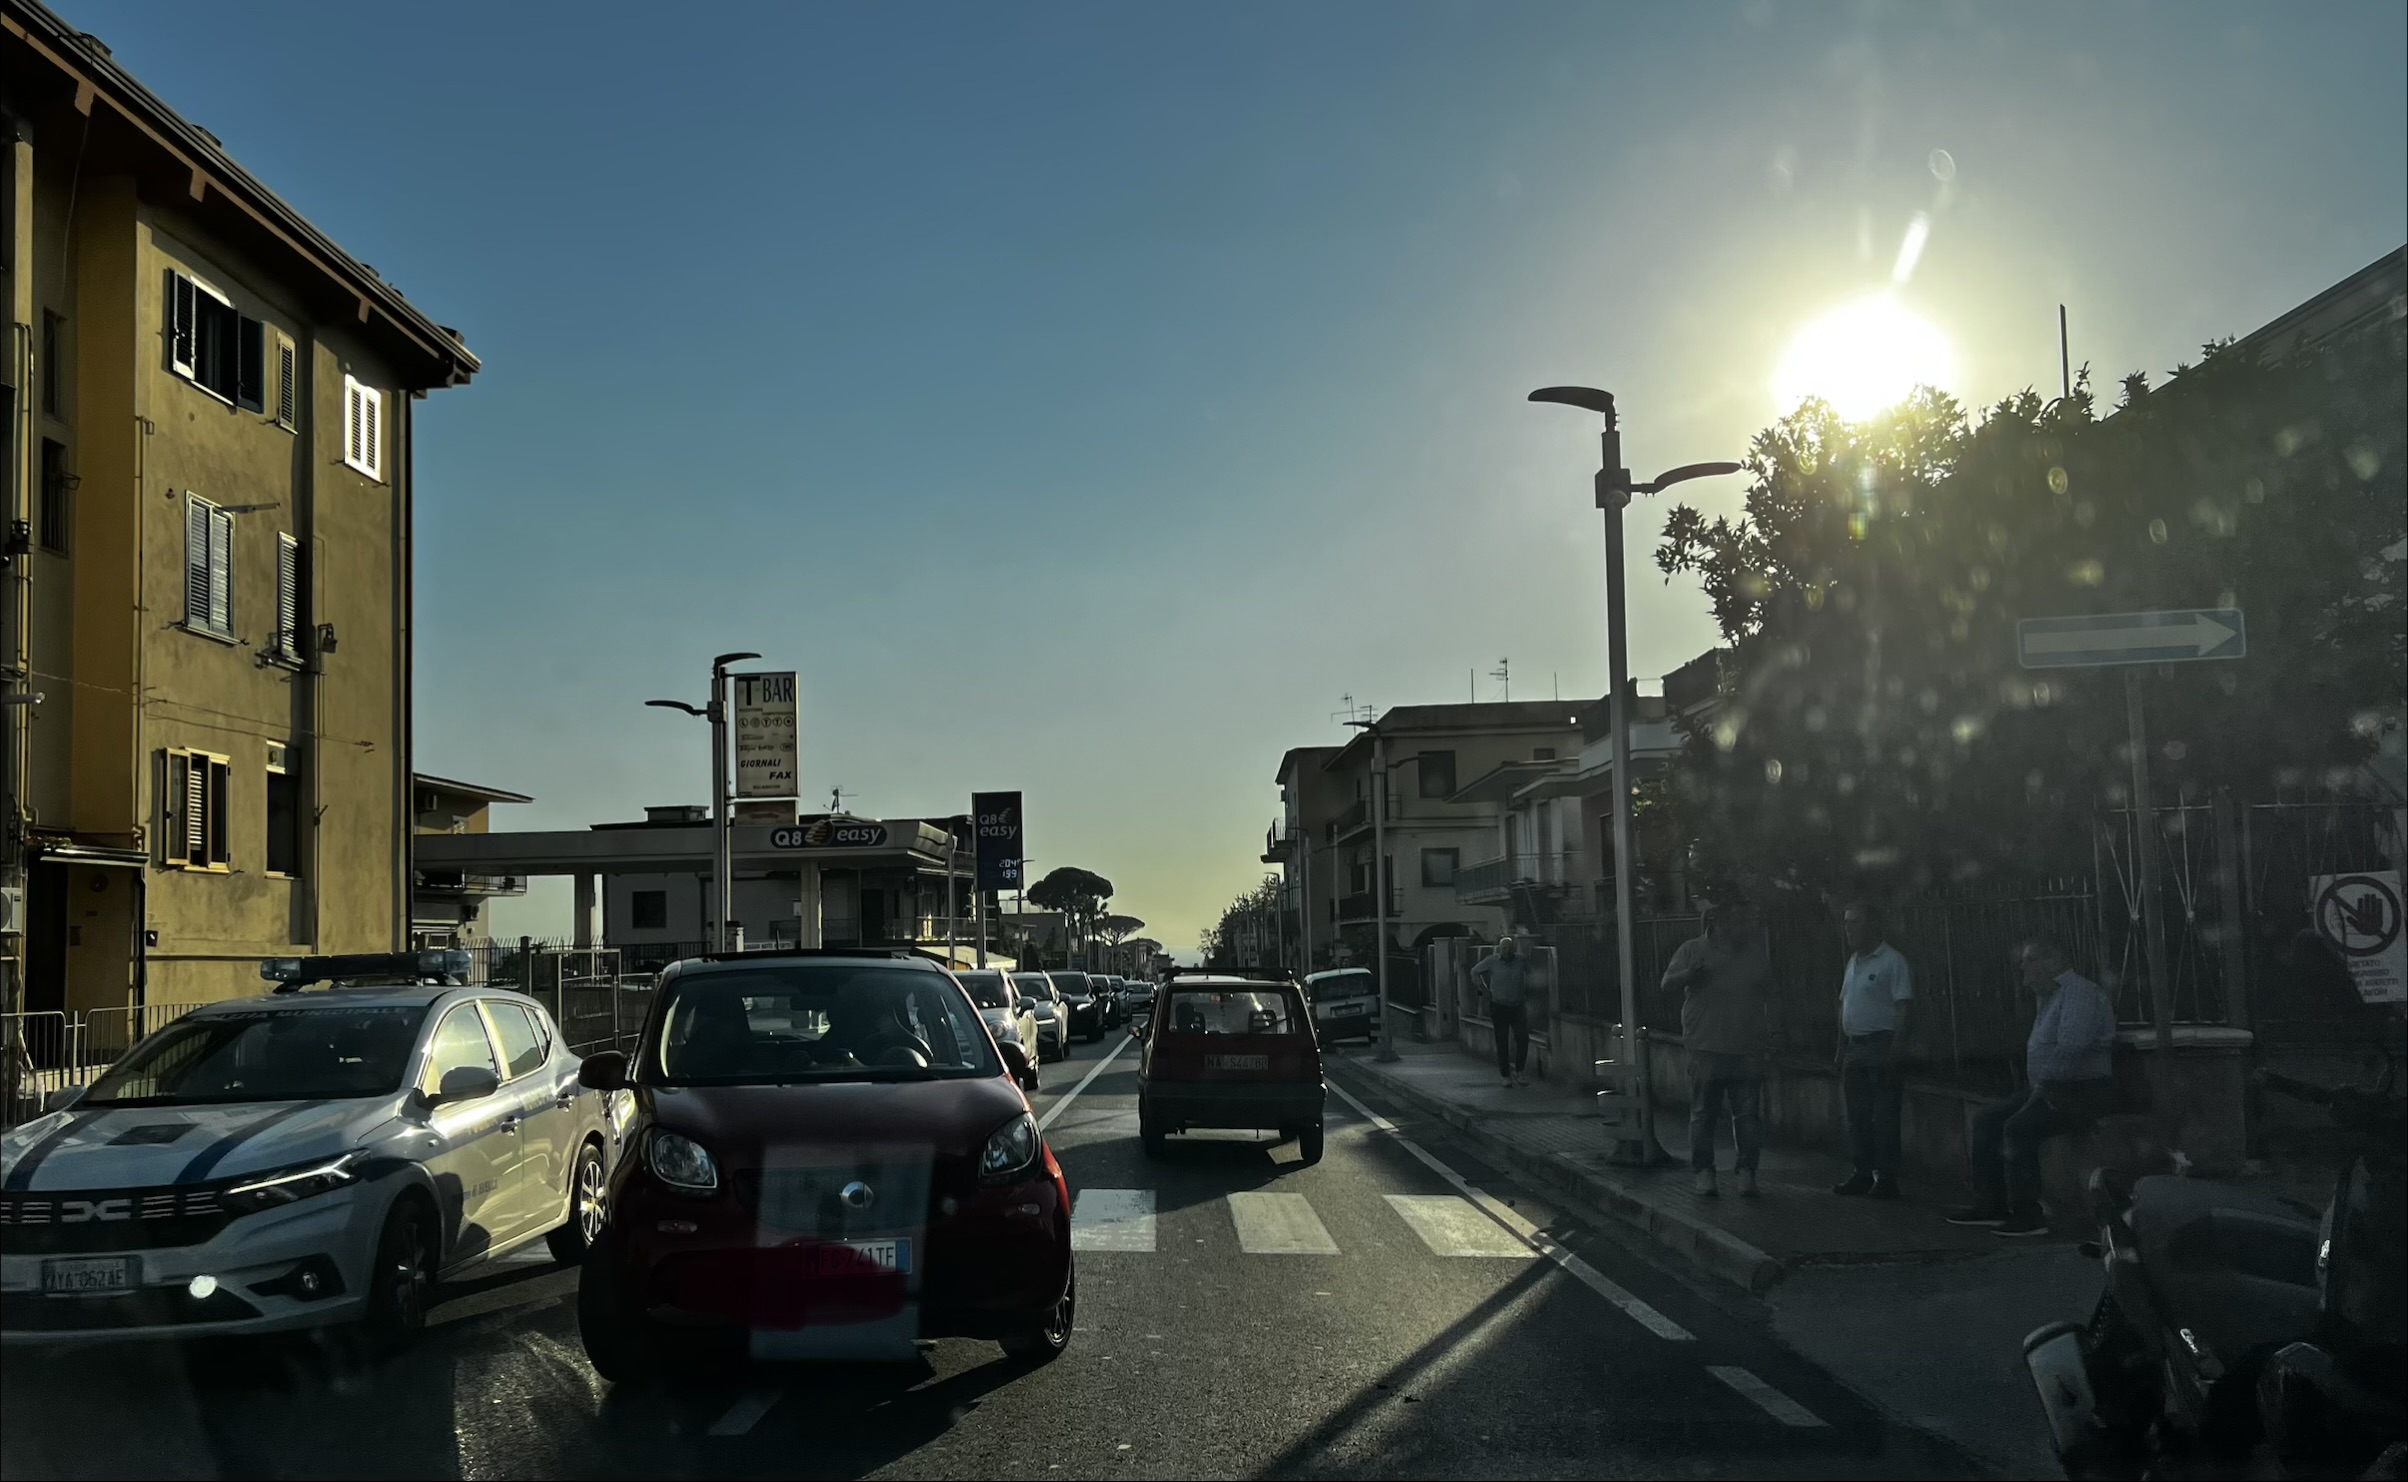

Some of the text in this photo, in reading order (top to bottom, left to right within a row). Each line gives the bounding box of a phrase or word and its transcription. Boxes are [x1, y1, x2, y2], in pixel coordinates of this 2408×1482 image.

[763, 678, 793, 703] BAR
[741, 759, 782, 768] GIORNALI
[769, 771, 792, 780] FAX
[980, 814, 997, 825] Q8
[775, 828, 881, 846] Q8 easy
[980, 825, 1017, 839] easy
